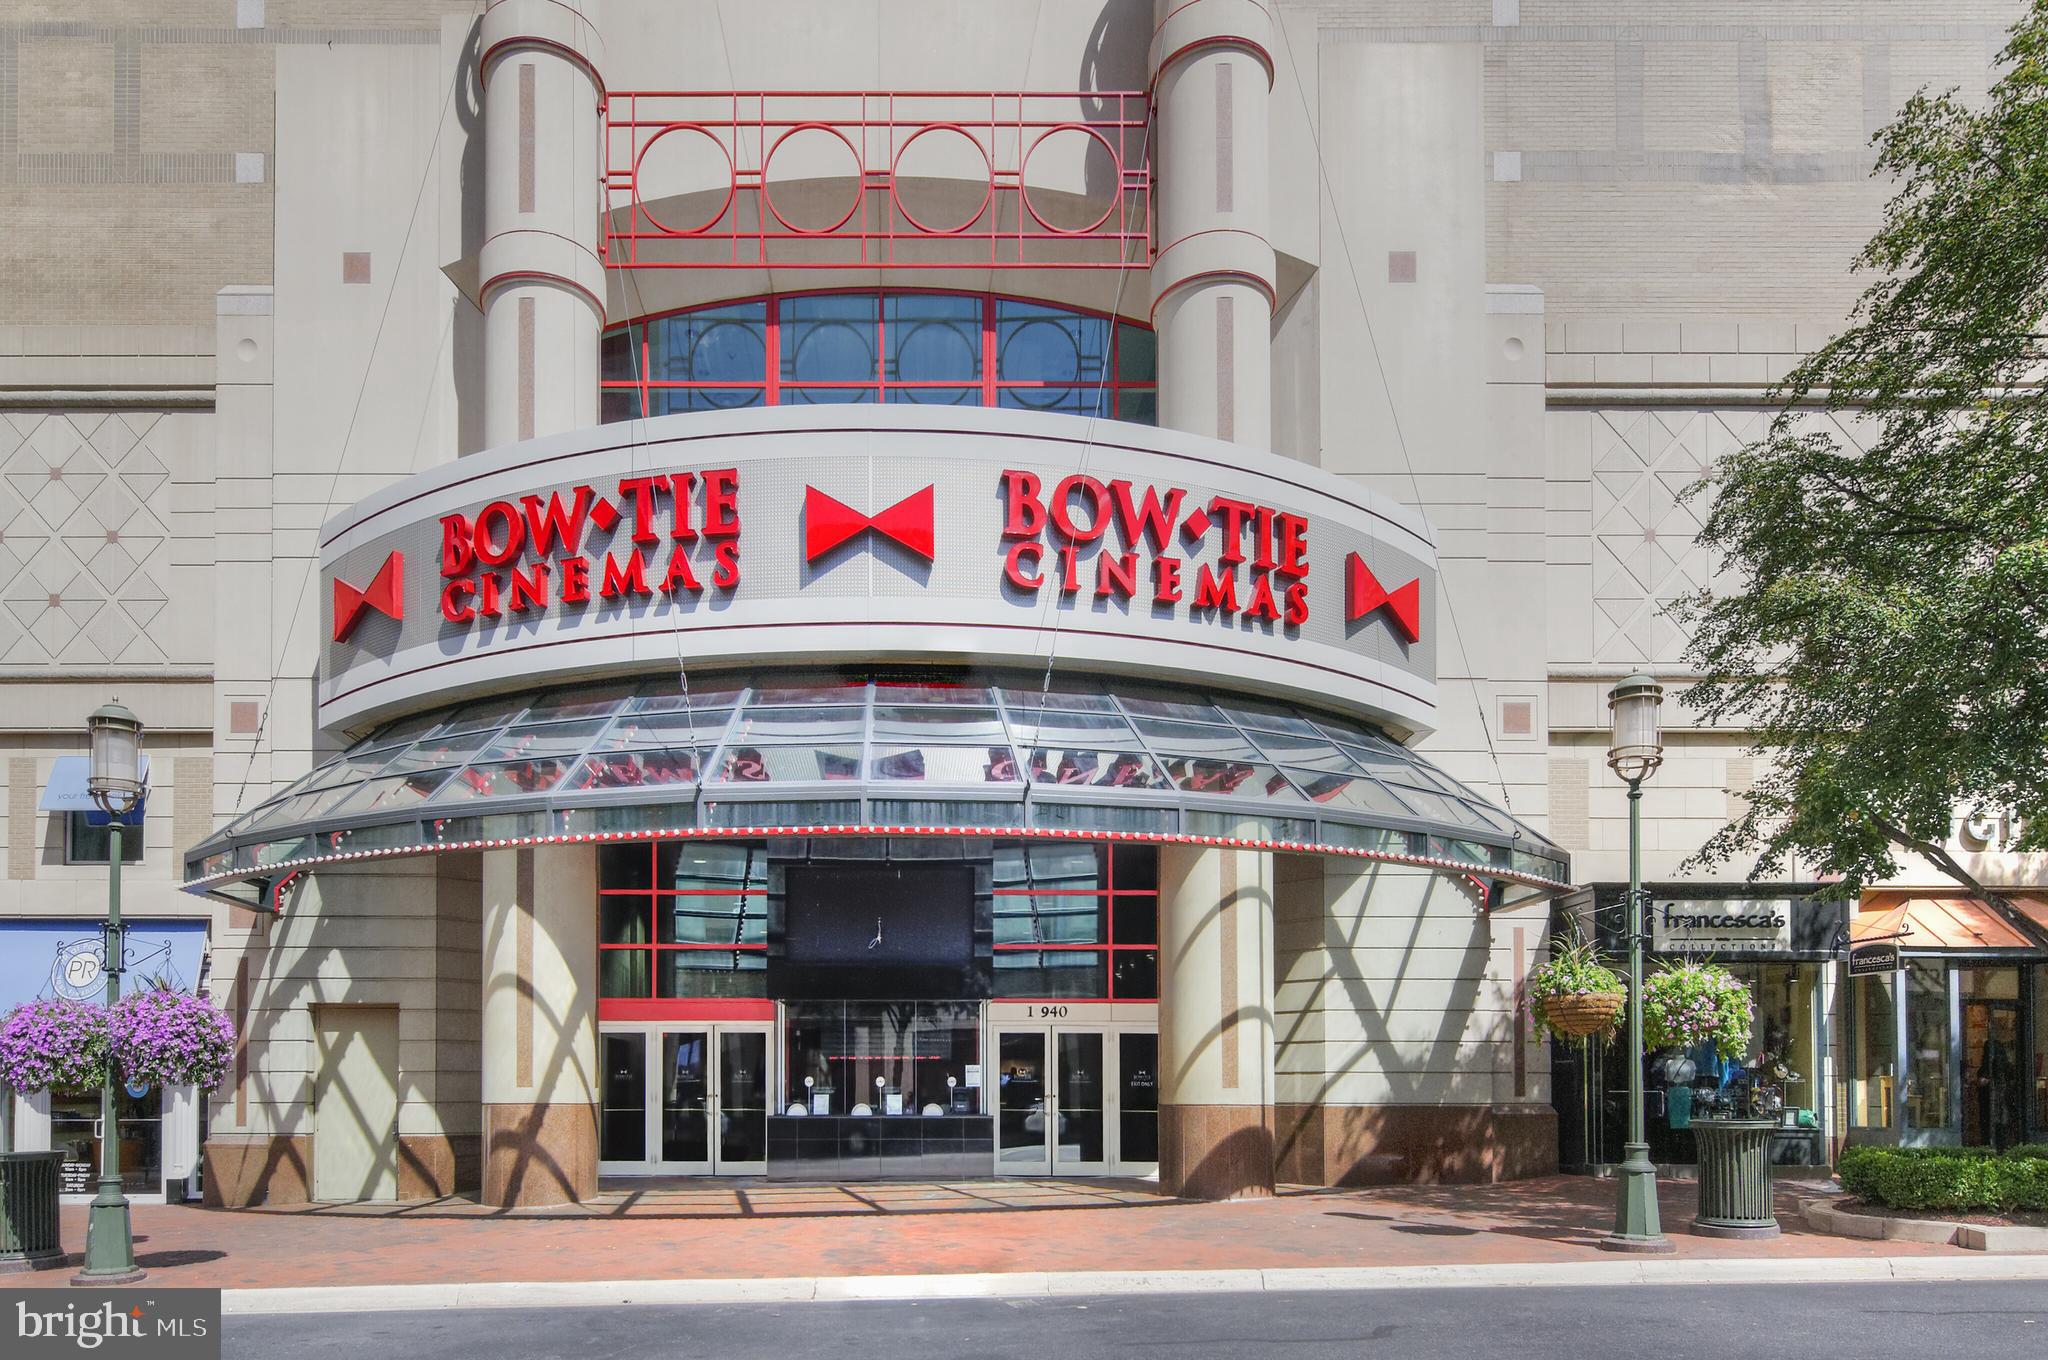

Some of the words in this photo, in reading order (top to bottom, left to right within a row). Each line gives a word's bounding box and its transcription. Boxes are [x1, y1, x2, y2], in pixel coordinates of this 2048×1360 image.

[440, 539, 741, 623] CINEMAS
[1004, 541, 1309, 626] CINEMAS
[1662, 902, 1786, 928] francesca's
[1669, 943, 1776, 951] COLLECTIONS
[68, 960, 97, 979] PR
[1852, 952, 1895, 966] francesca's
